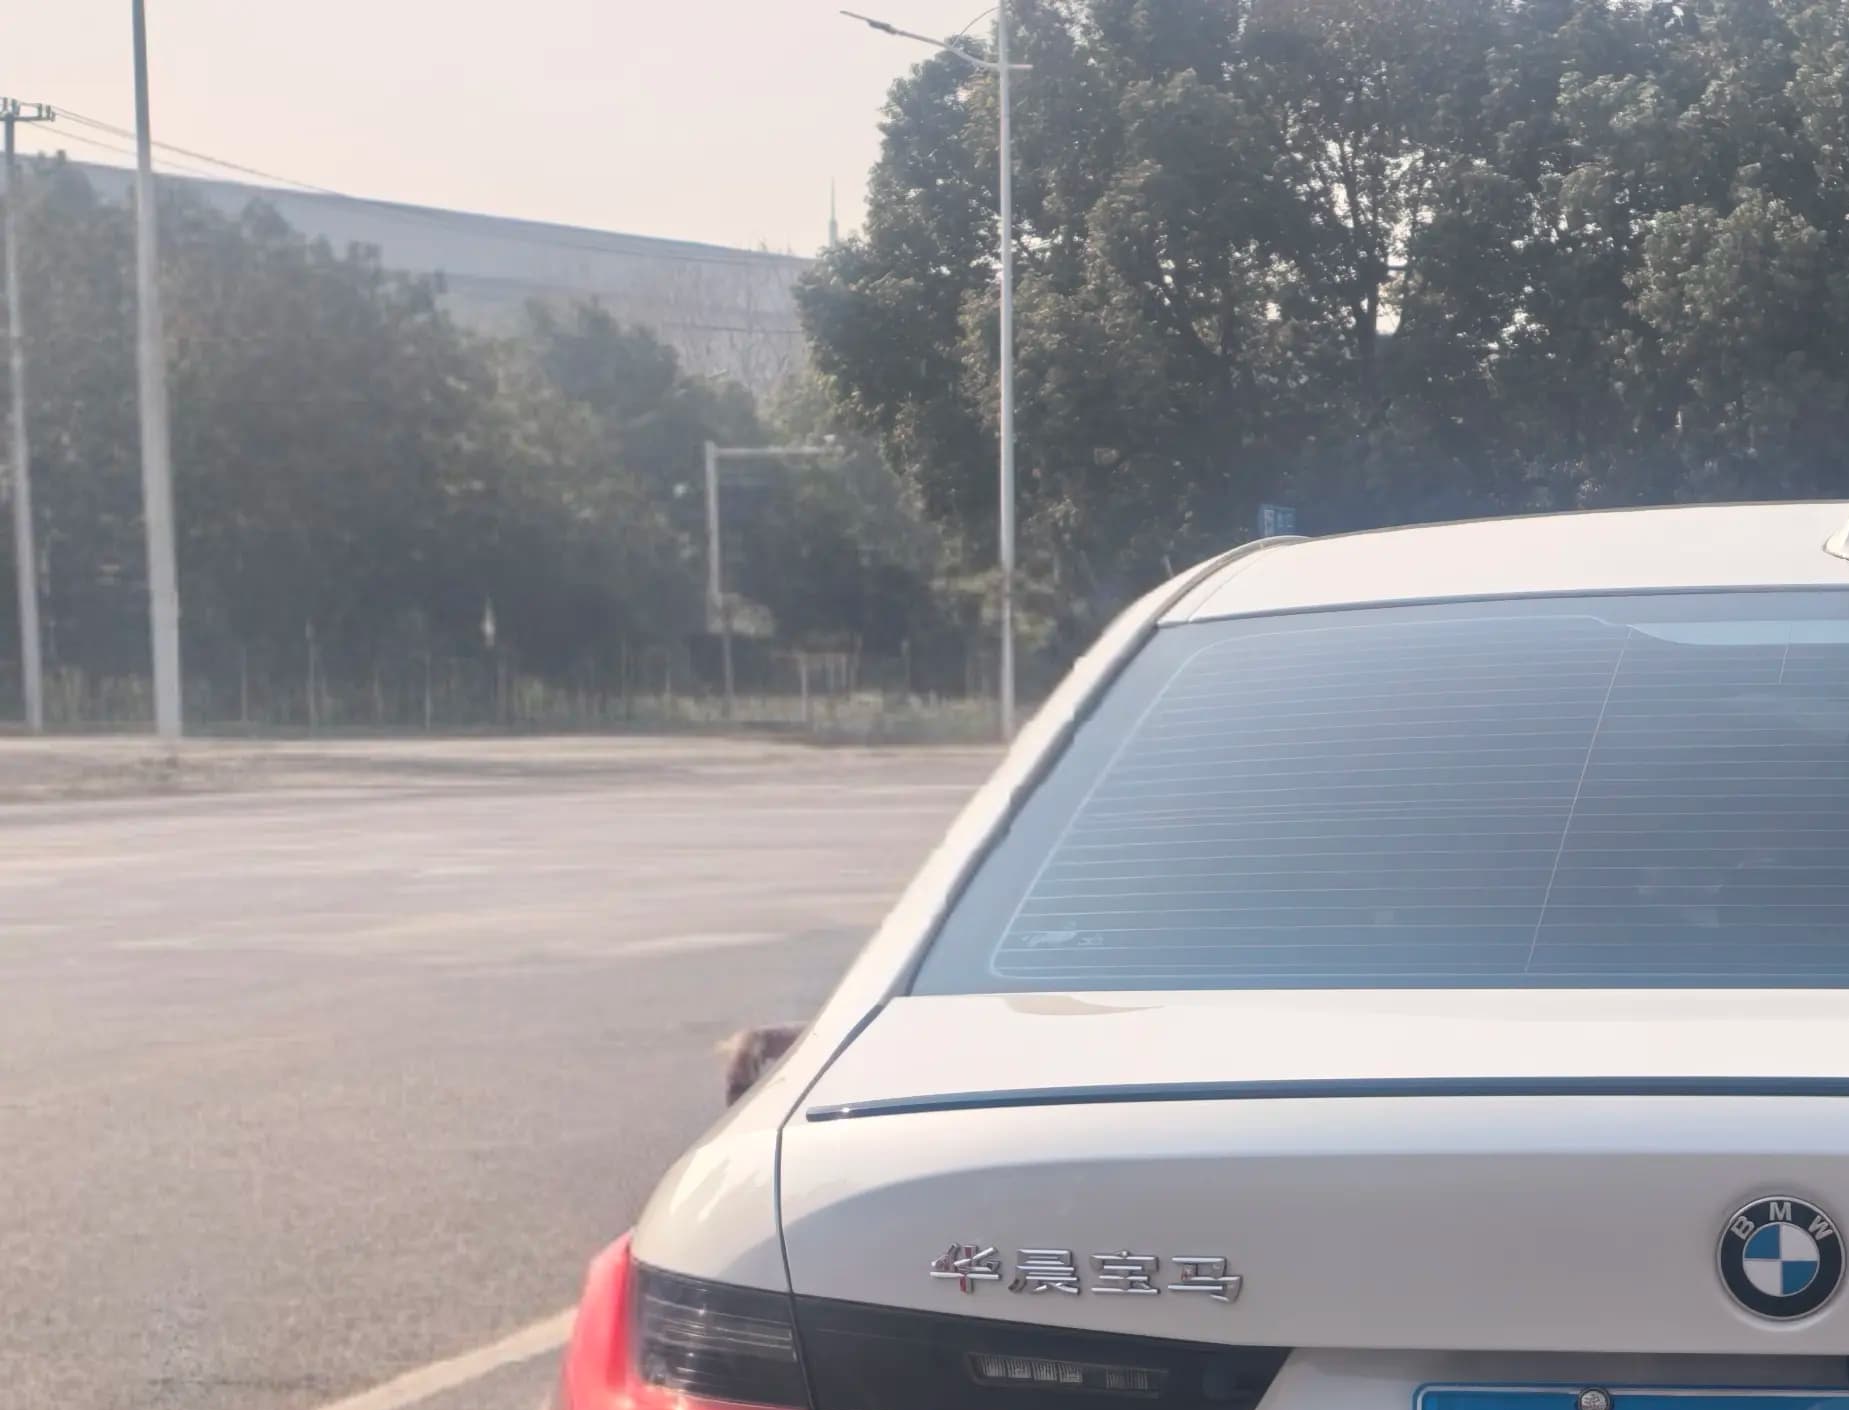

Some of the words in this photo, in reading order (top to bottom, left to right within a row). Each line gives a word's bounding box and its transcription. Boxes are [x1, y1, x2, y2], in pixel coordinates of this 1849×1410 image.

[1730, 1201, 1833, 1241] BMW
[928, 1241, 1244, 1302] 华晨宝马
